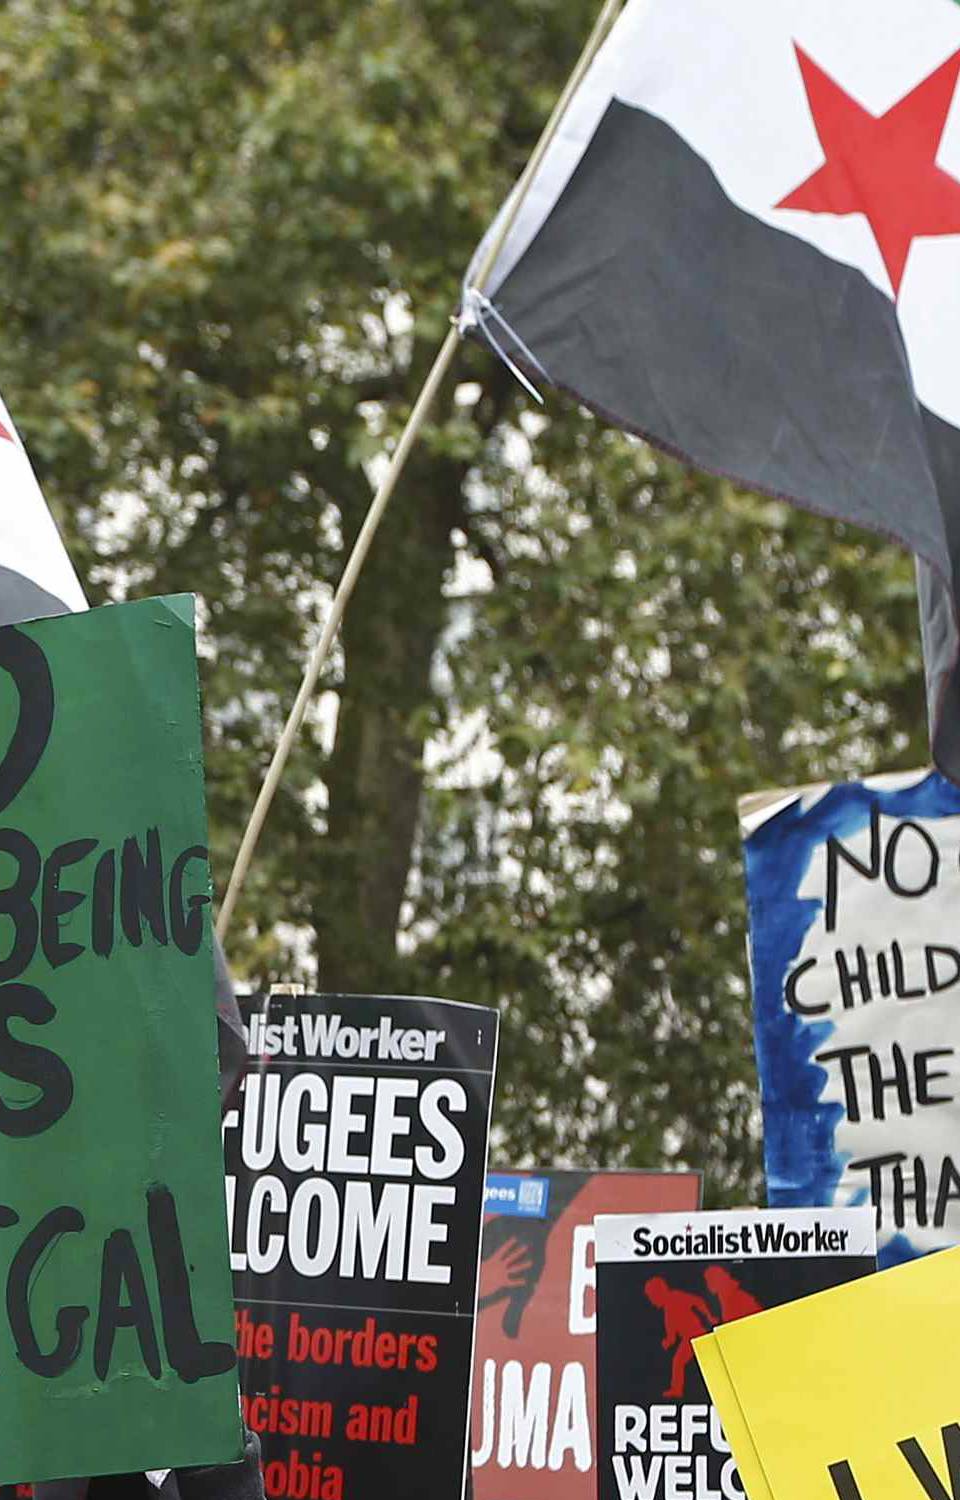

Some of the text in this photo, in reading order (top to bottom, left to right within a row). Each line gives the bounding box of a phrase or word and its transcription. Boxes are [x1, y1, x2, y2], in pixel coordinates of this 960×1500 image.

[825, 799, 940, 933] NO
[785, 938, 960, 1014] CHILD
[301, 1013, 446, 1062] Worker
[815, 1041, 955, 1123] THE
[222, 1072, 468, 1181] UGEES
[633, 1221, 849, 1257] Socialist Worker
[288, 1311, 439, 1373] borders
[345, 1394, 419, 1446] and
